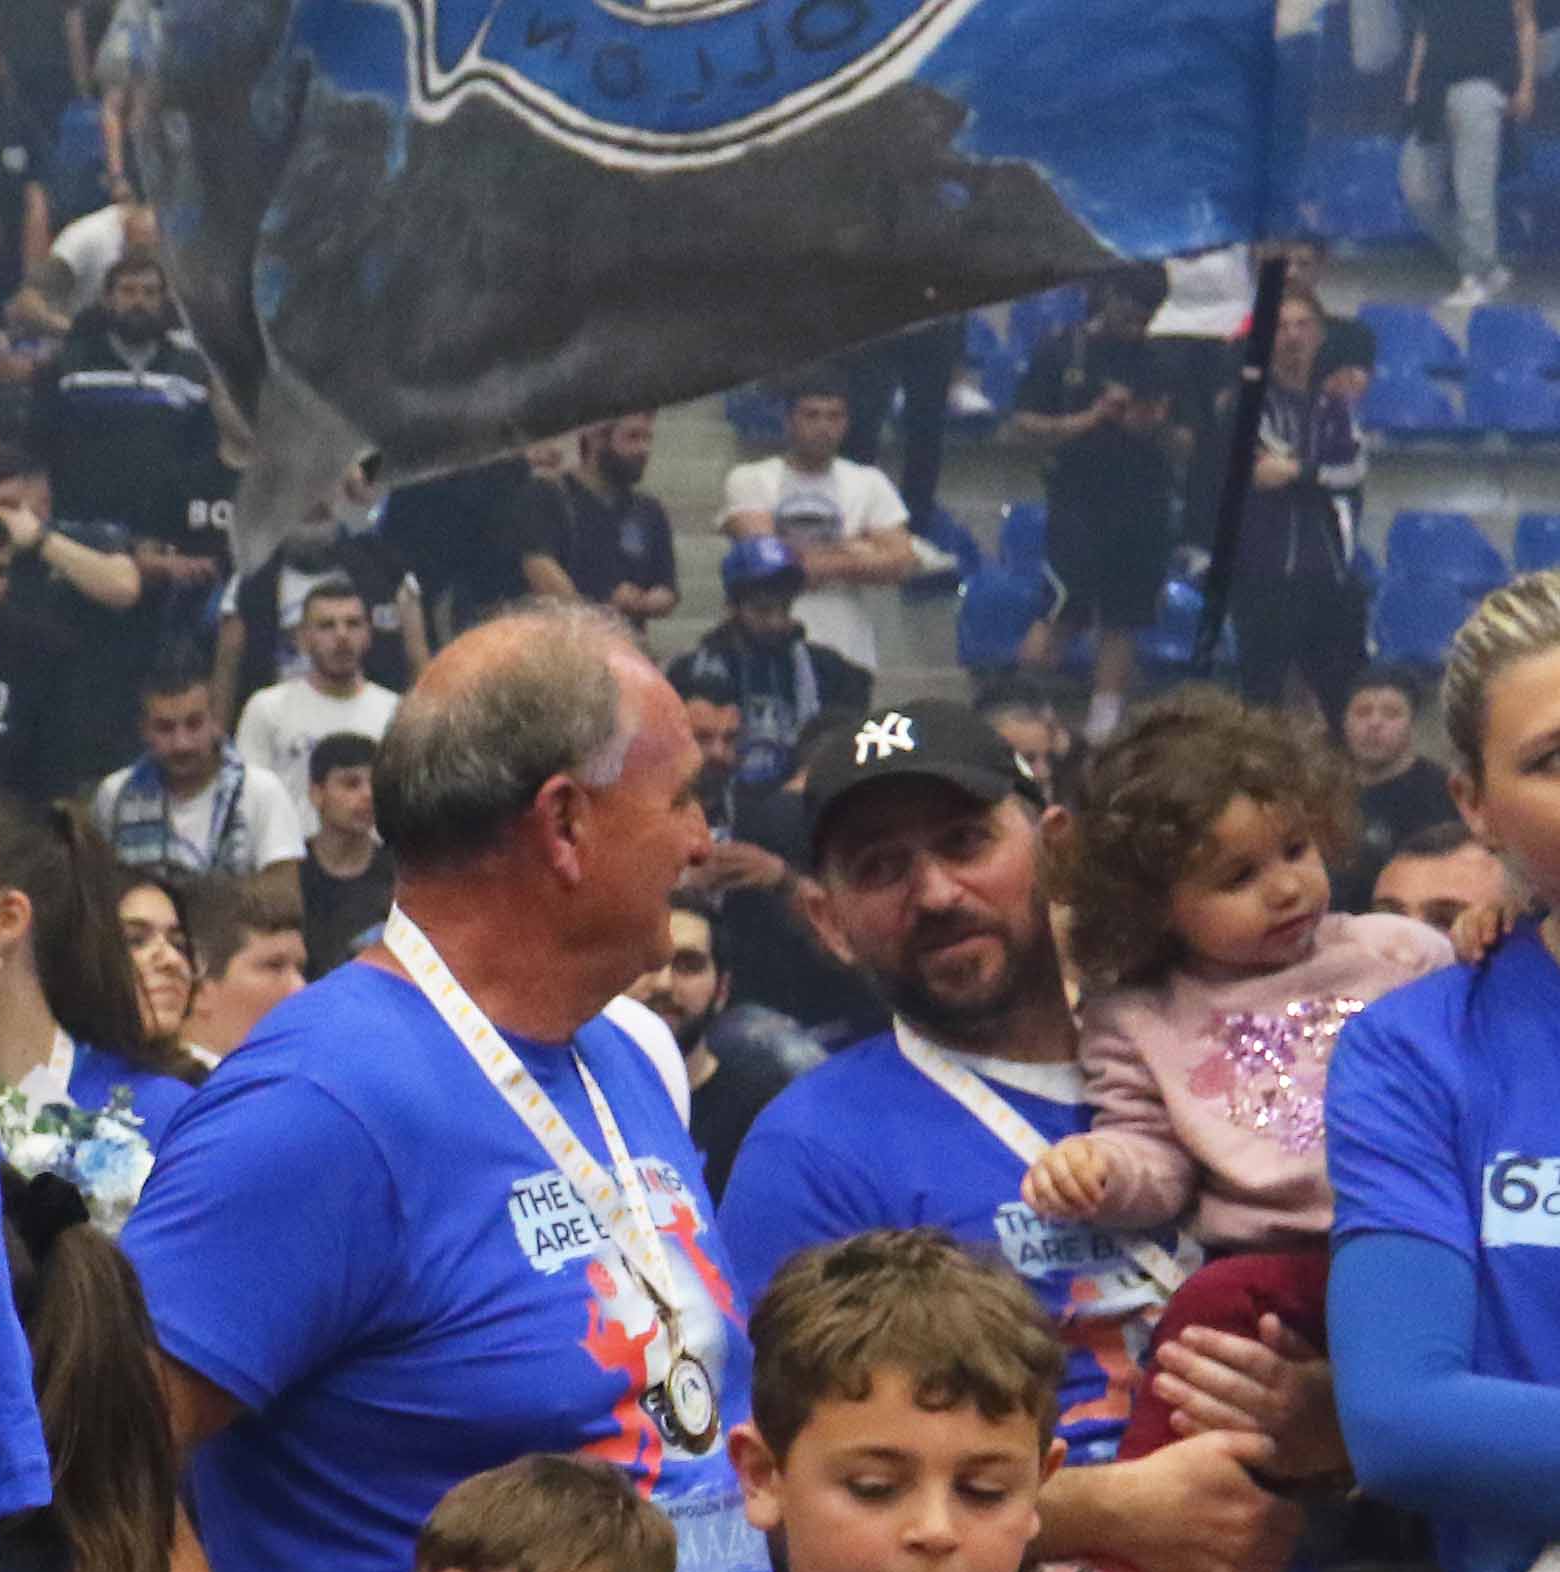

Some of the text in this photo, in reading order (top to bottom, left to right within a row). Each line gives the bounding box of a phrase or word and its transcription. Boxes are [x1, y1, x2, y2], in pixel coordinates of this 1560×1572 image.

[512, 1179, 570, 1219] THE
[1489, 1157, 1541, 1214] 6
[536, 1217, 591, 1257] ARE
